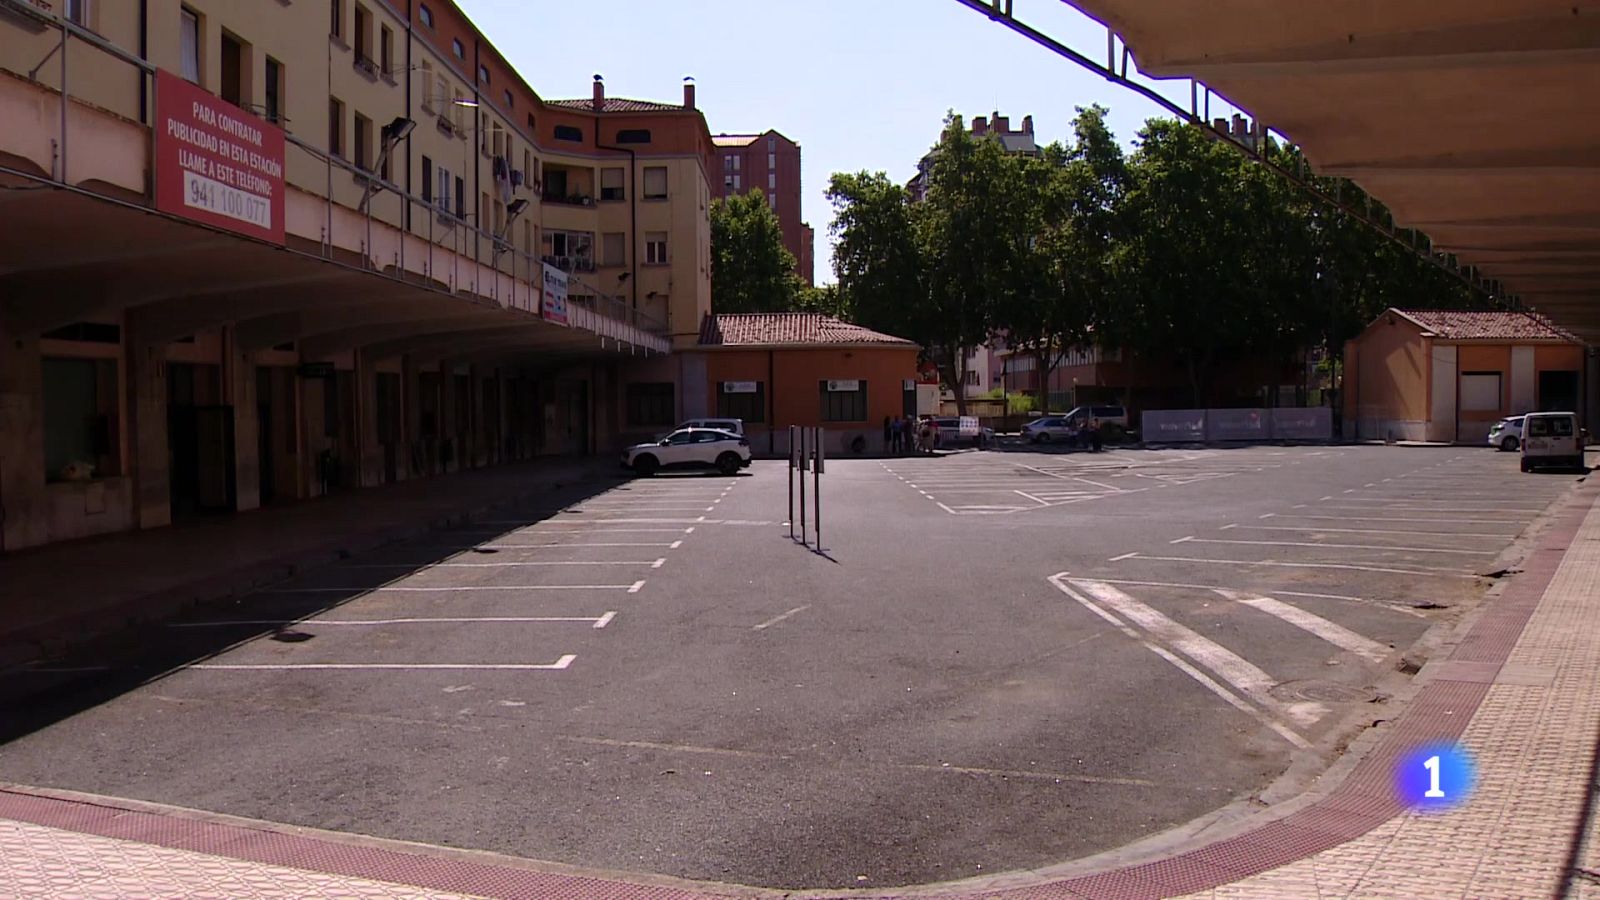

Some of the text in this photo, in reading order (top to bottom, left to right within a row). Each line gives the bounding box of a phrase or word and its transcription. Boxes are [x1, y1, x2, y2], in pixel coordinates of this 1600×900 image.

[193, 102, 262, 147] PARA CONTRATAR
[168, 118, 281, 178] PUBLICIDAD EN ESTA ESTACIÓN
[179, 149, 272, 196] LLAME A ESTE TELÉFONO:
[191, 179, 266, 225] 941 100 077
